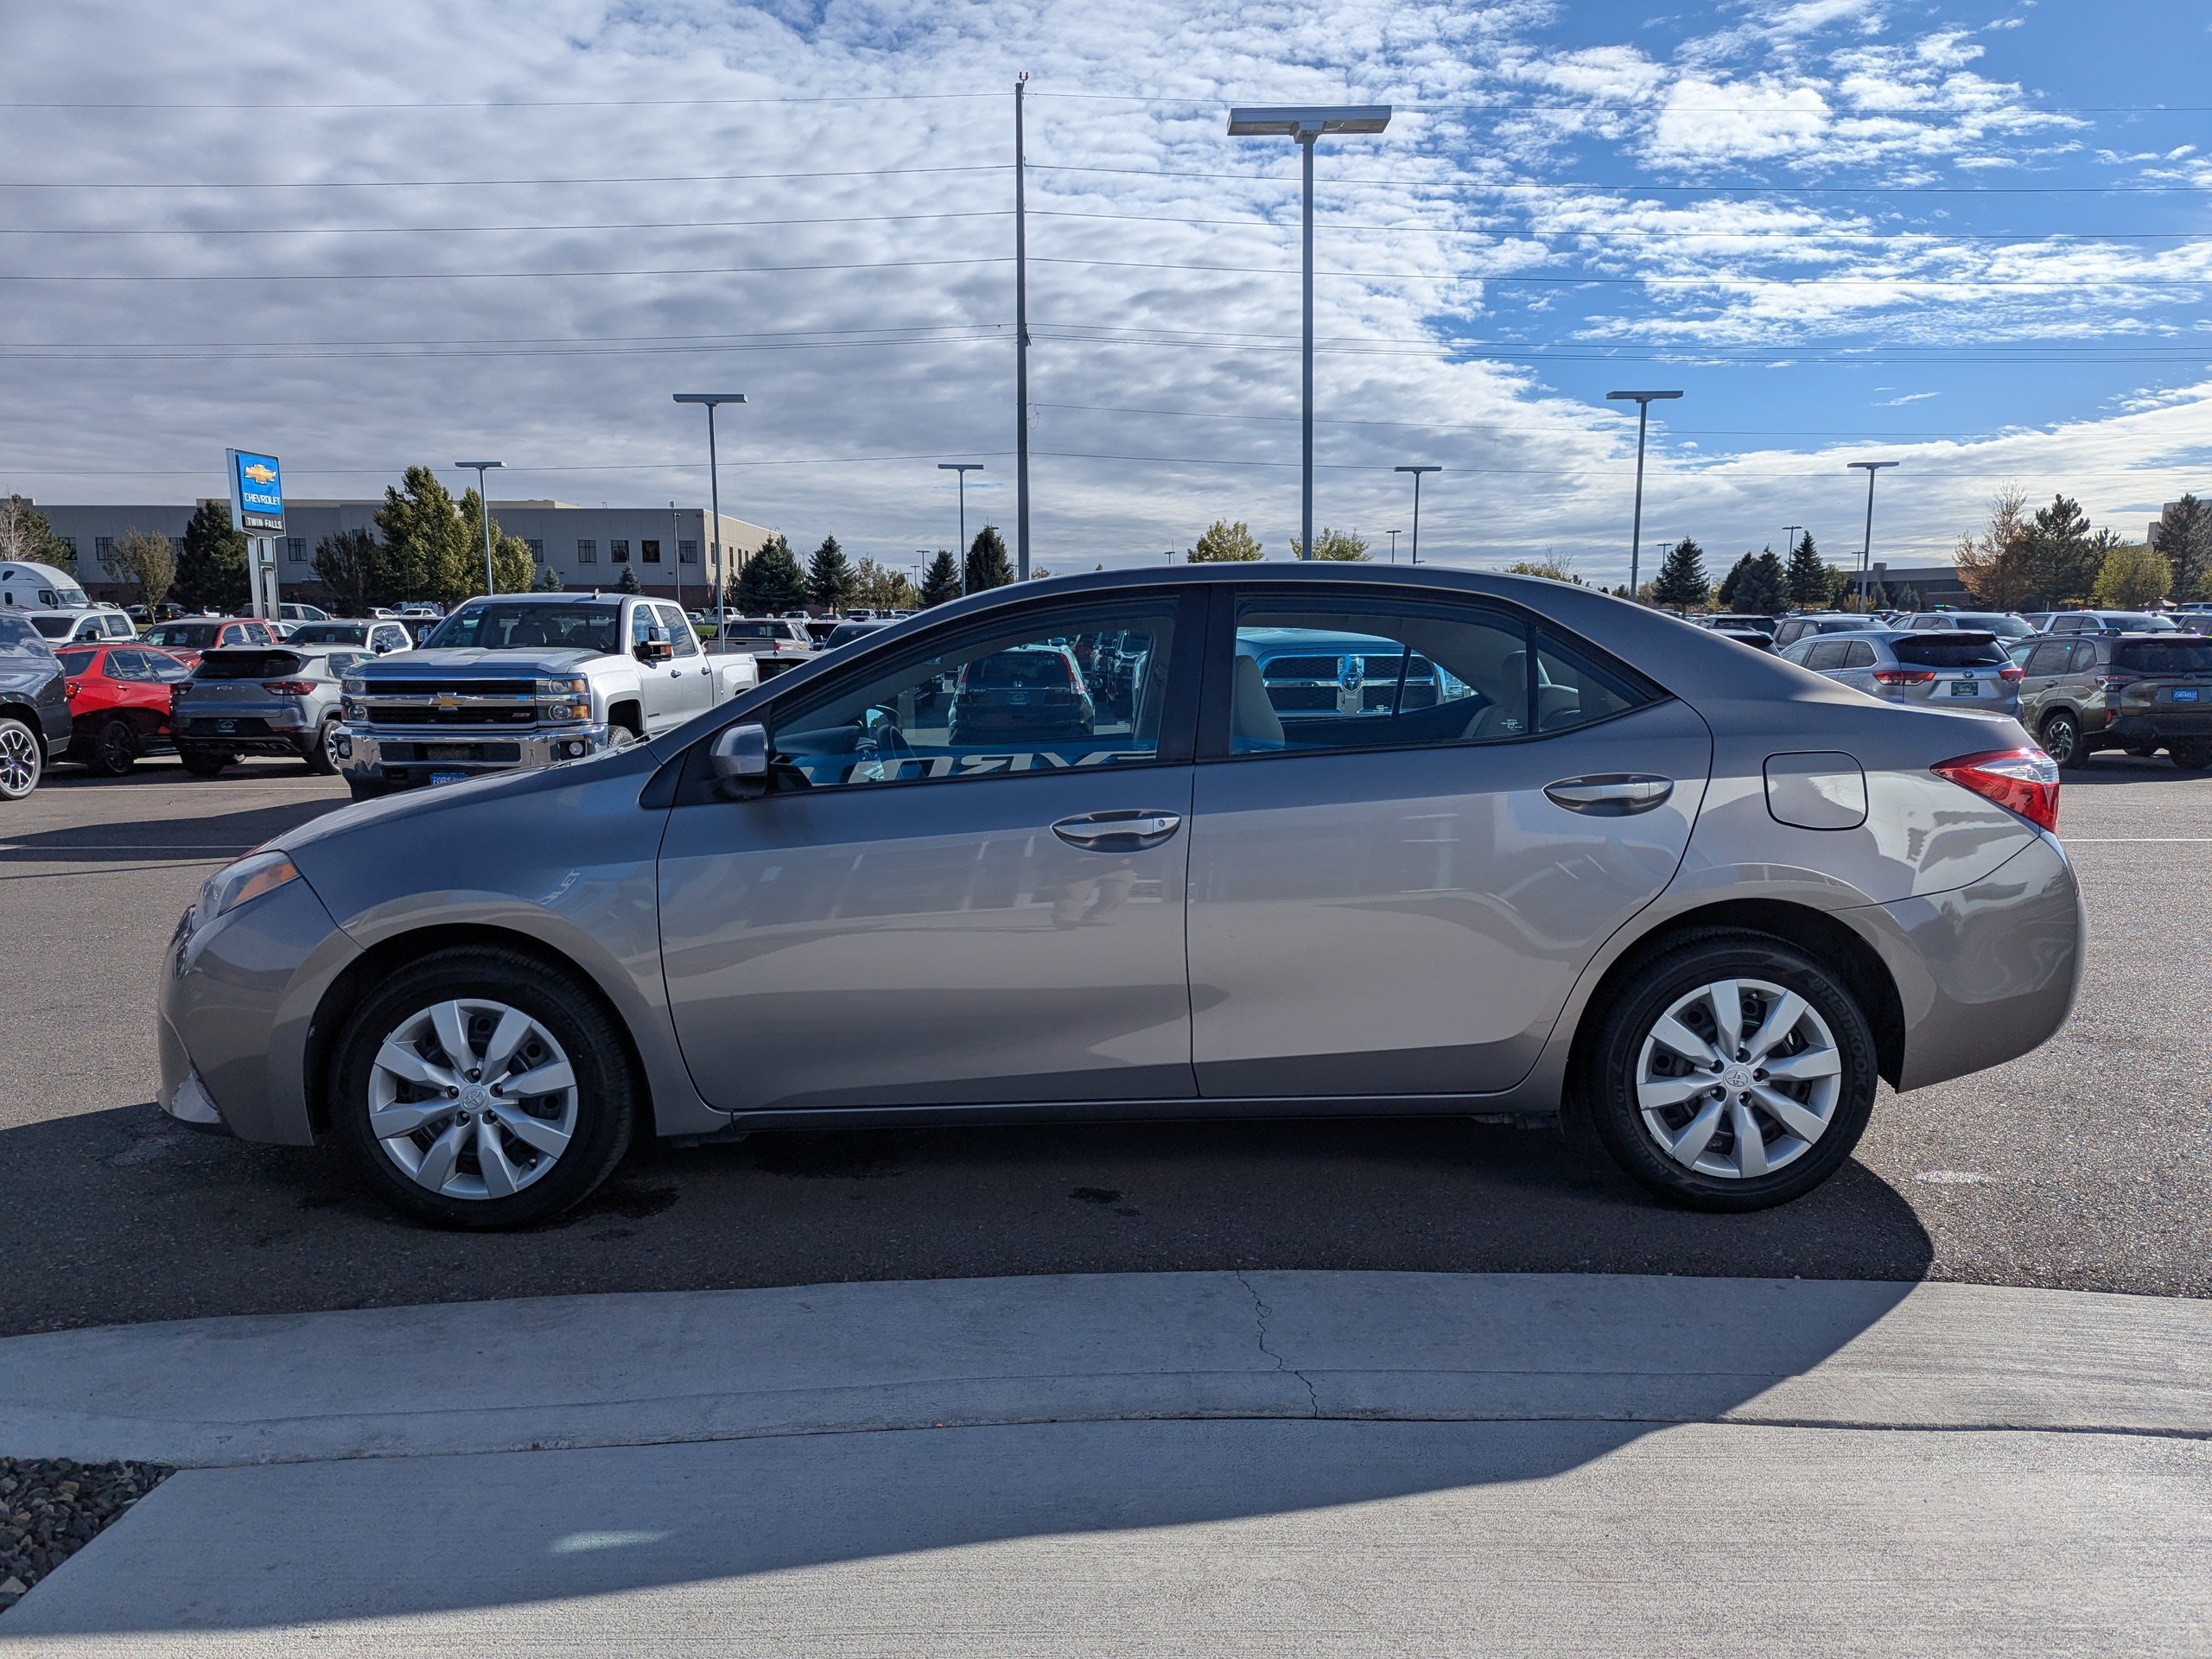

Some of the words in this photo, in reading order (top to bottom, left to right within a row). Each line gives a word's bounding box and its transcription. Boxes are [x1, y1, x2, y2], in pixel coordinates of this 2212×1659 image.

[244, 493, 281, 505] CHEVROLET
[247, 517, 264, 527] TWIN
[264, 519, 283, 530] FALLS
